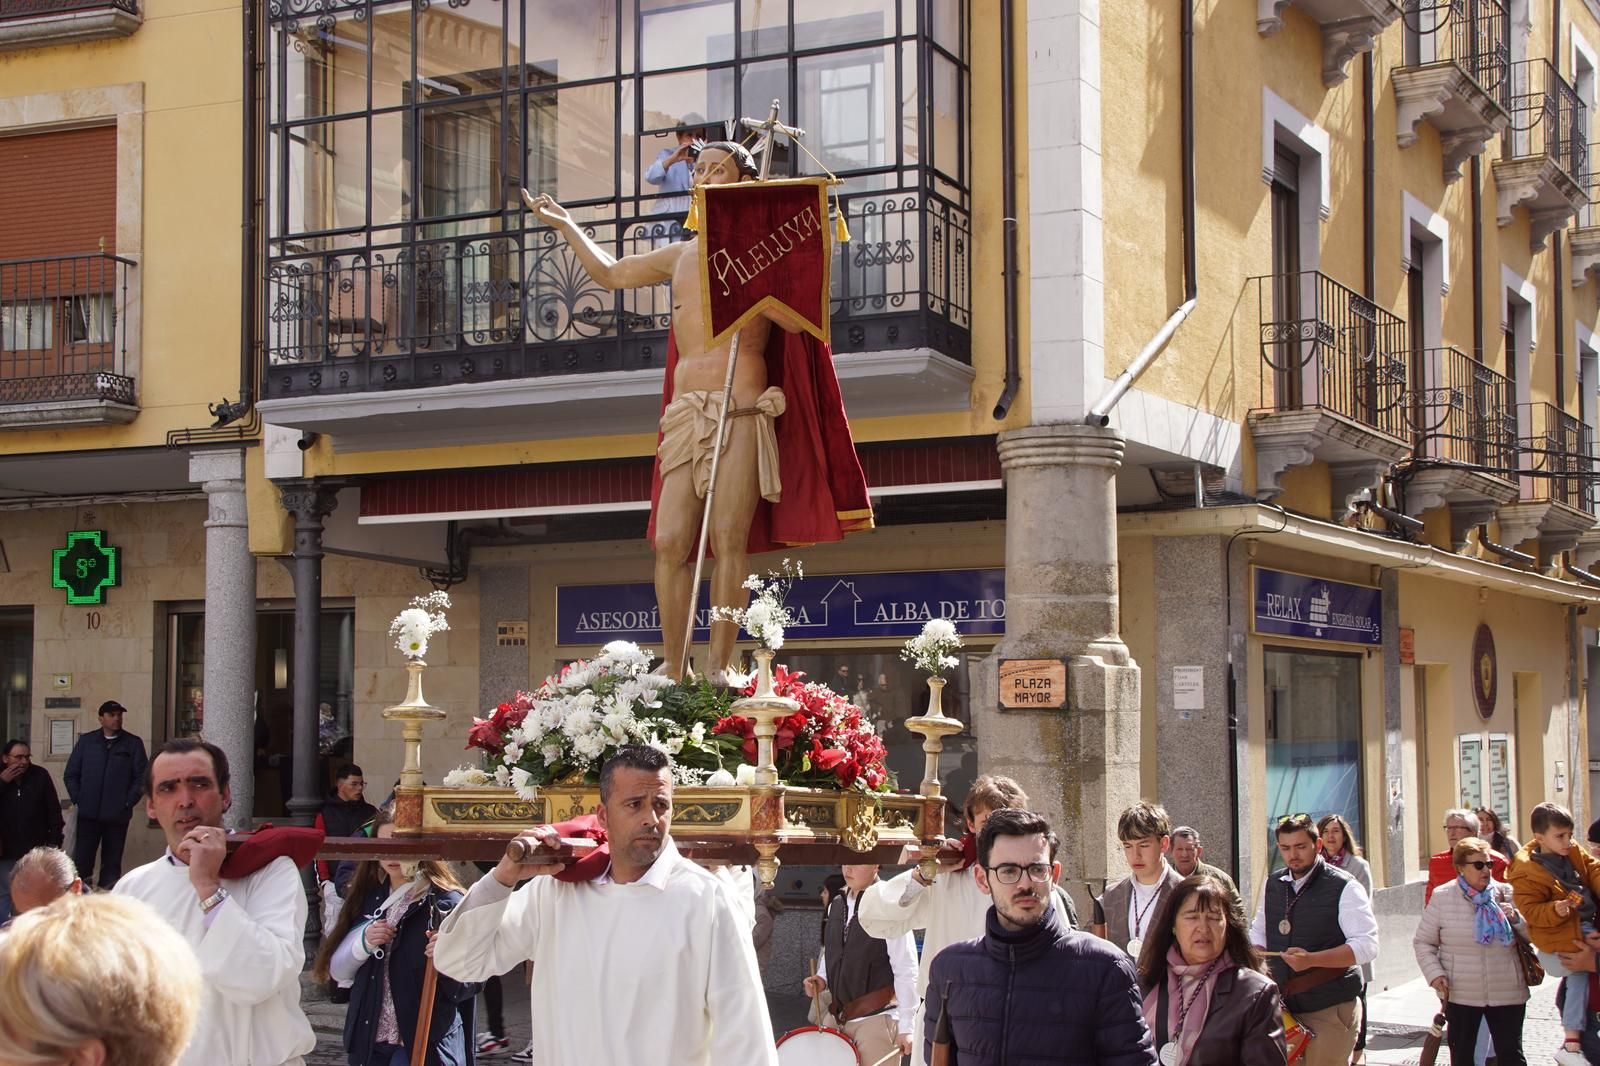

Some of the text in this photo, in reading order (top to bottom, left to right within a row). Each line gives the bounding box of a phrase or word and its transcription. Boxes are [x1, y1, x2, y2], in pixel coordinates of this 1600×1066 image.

[708, 206, 821, 296] ALELUYA
[873, 601, 932, 622] ALBA
[939, 600, 970, 619] DE
[1267, 593, 1301, 620] RELAX
[86, 612, 100, 630] 10
[576, 606, 661, 630] ASESORÍ
[1014, 678, 1051, 689] PLAZA
[1014, 692, 1051, 703] MAYOR
